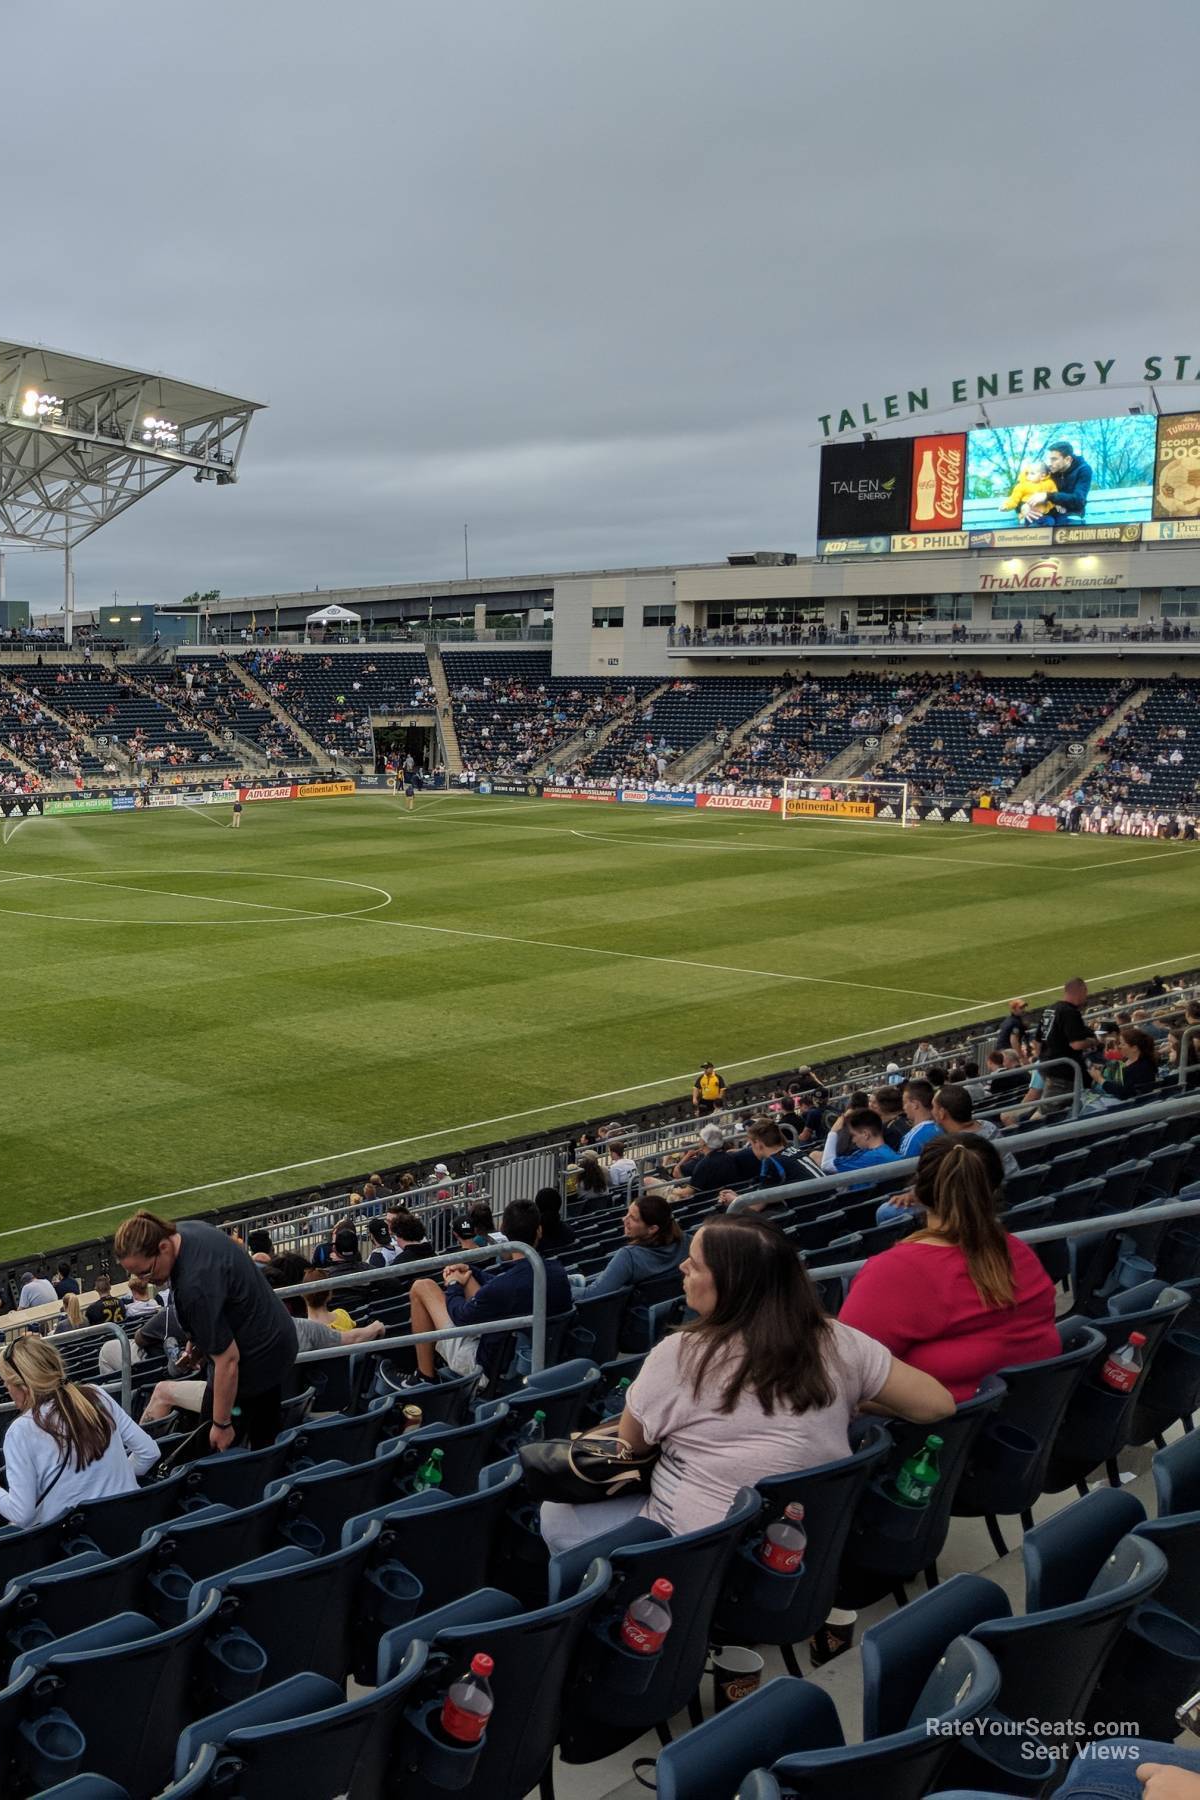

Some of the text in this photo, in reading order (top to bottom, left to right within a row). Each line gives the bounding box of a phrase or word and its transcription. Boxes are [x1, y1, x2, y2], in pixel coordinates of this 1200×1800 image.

[818, 355, 1200, 437] TALEN ENERGY ST
[1161, 439, 1192, 448] SCOOP
[830, 478, 880, 494] TALEN
[935, 446, 962, 519] Coca-Cola
[858, 491, 893, 501] ENERGY
[923, 534, 969, 548] PHILLY
[1069, 529, 1096, 540] ACTION
[1097, 528, 1121, 539] NEWS
[980, 571, 1118, 590] TruMark Financial
[246, 787, 291, 800] ADVOCARE
[300, 784, 334, 797] Continental
[623, 792, 646, 801] BIMBO
[706, 796, 772, 810] ADVOCARE
[785, 799, 871, 814] Continental TIRE
[996, 811, 1030, 828] Coca-Cola
